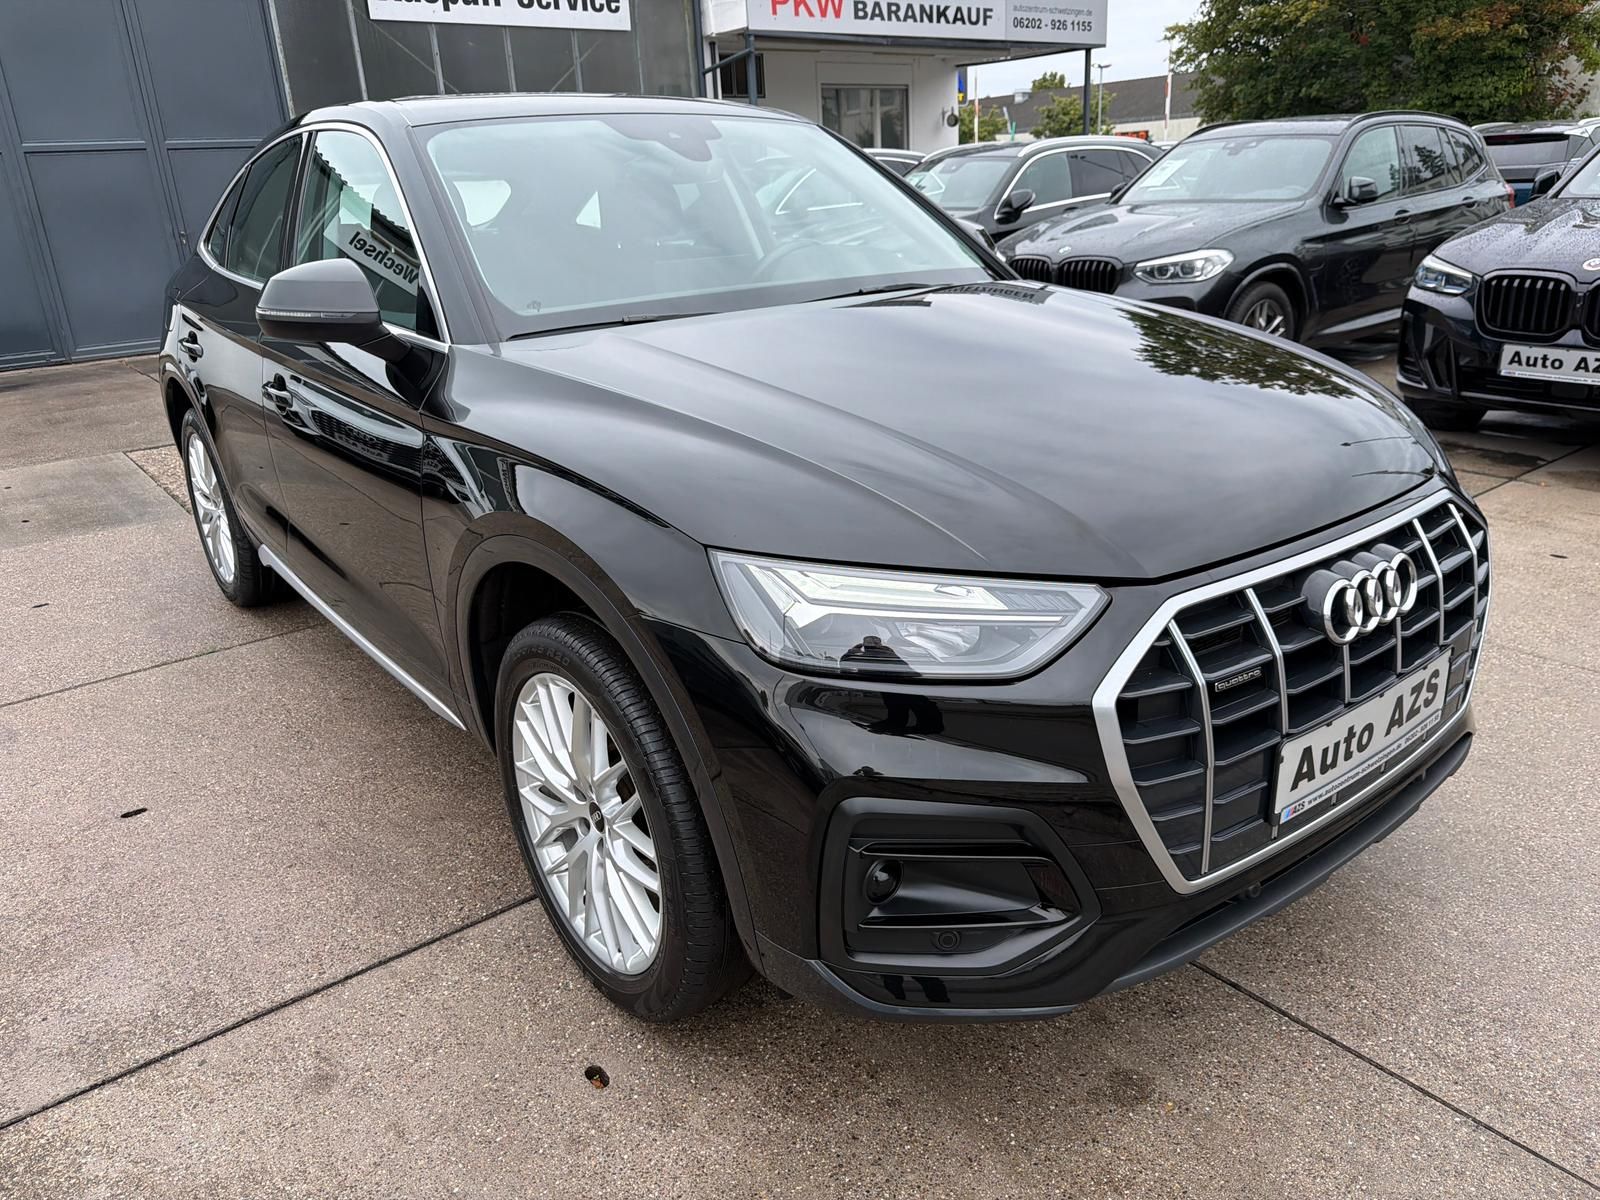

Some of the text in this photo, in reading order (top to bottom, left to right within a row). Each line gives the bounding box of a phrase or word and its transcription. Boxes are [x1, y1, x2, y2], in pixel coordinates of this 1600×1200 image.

[771, 0, 993, 26] PKW BARANKAUF
[1013, 17, 1042, 29] 06202
[1050, 19, 1068, 31] 926
[1071, 20, 1092, 32] 1155
[1508, 350, 1564, 370] Auto
[1218, 669, 1261, 689] quattro
[1290, 668, 1440, 792] Auto AZS
